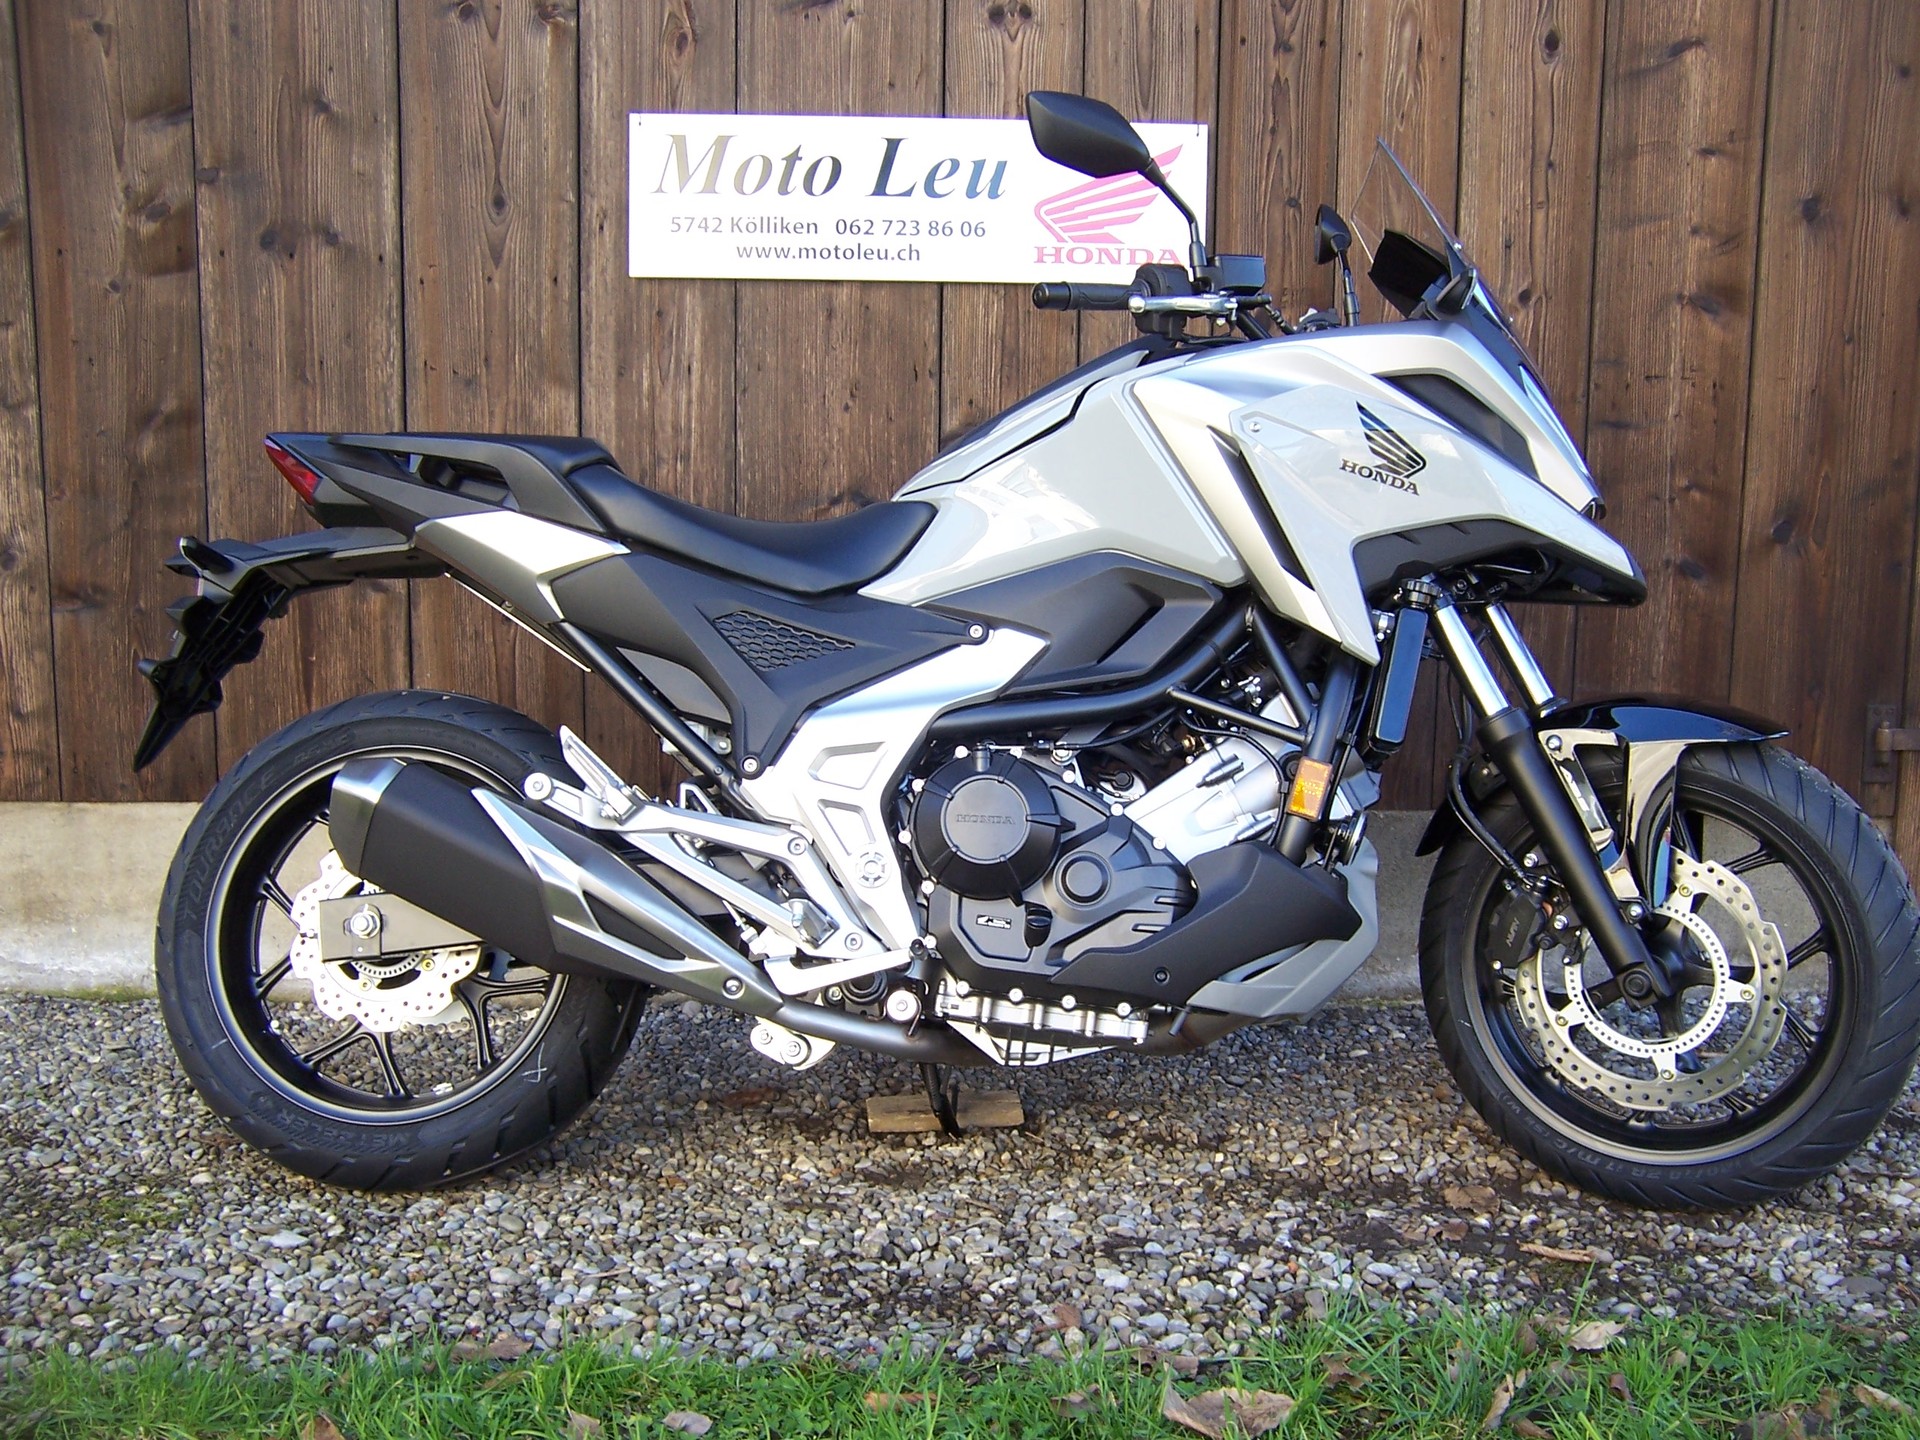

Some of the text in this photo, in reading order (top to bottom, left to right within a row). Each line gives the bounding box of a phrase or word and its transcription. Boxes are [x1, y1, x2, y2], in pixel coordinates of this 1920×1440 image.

[650, 133, 1008, 200] Moto Leu
[670, 216, 986, 237] 5742 Kölliken 062 723 86 06
[736, 242, 920, 261] www.motoleu.ch
[1034, 246, 1184, 266] HONDA
[1339, 458, 1420, 496] HONDA
[956, 813, 1016, 826] HONDA
